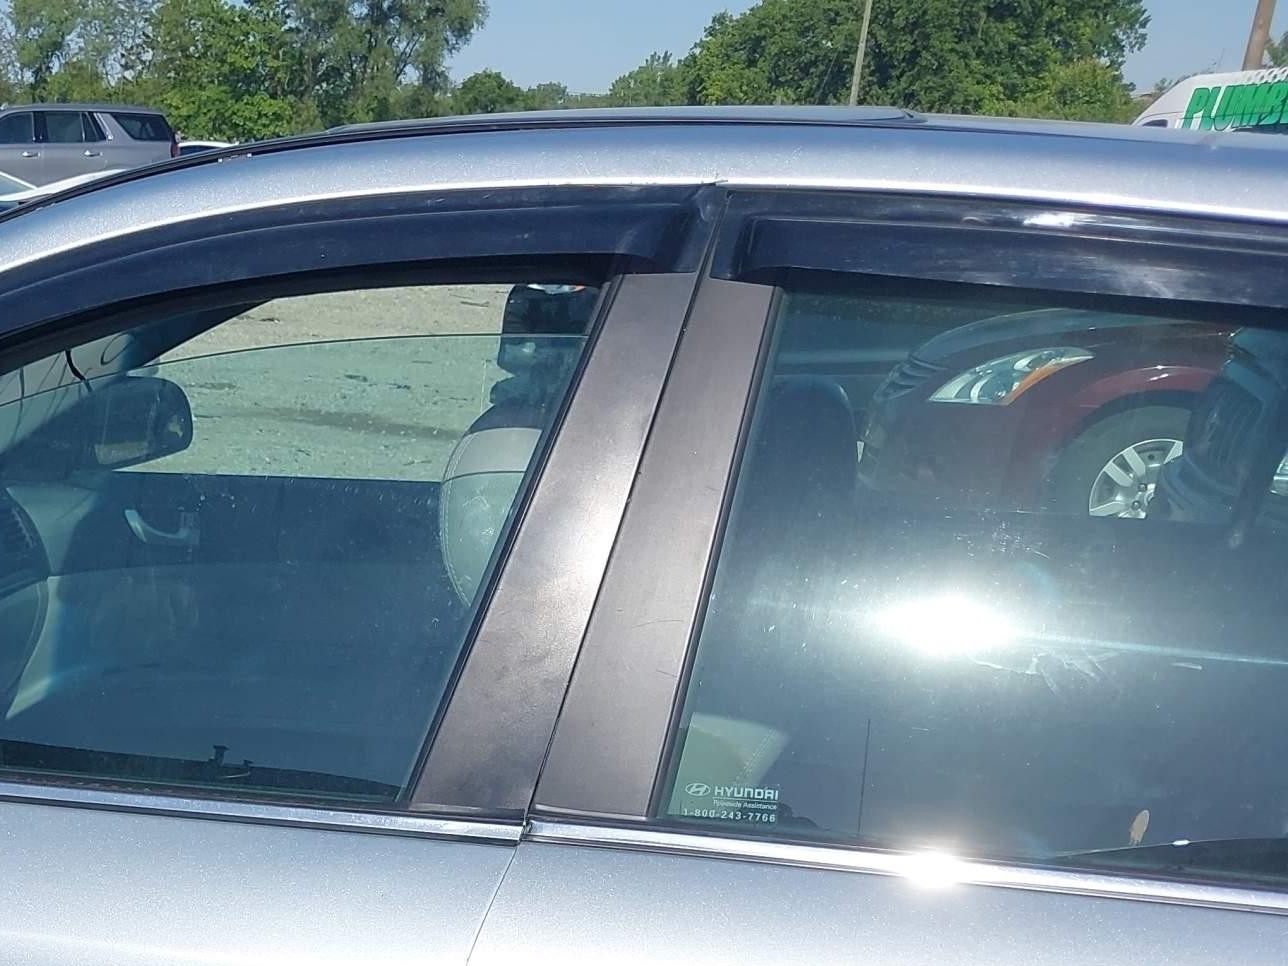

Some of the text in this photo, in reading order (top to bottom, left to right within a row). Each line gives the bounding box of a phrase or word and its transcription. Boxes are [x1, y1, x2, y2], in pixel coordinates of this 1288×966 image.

[714, 785, 779, 800] HYUNDAI
[743, 802, 777, 810] Assistance
[683, 808, 776, 823] 1-800-243-7766
